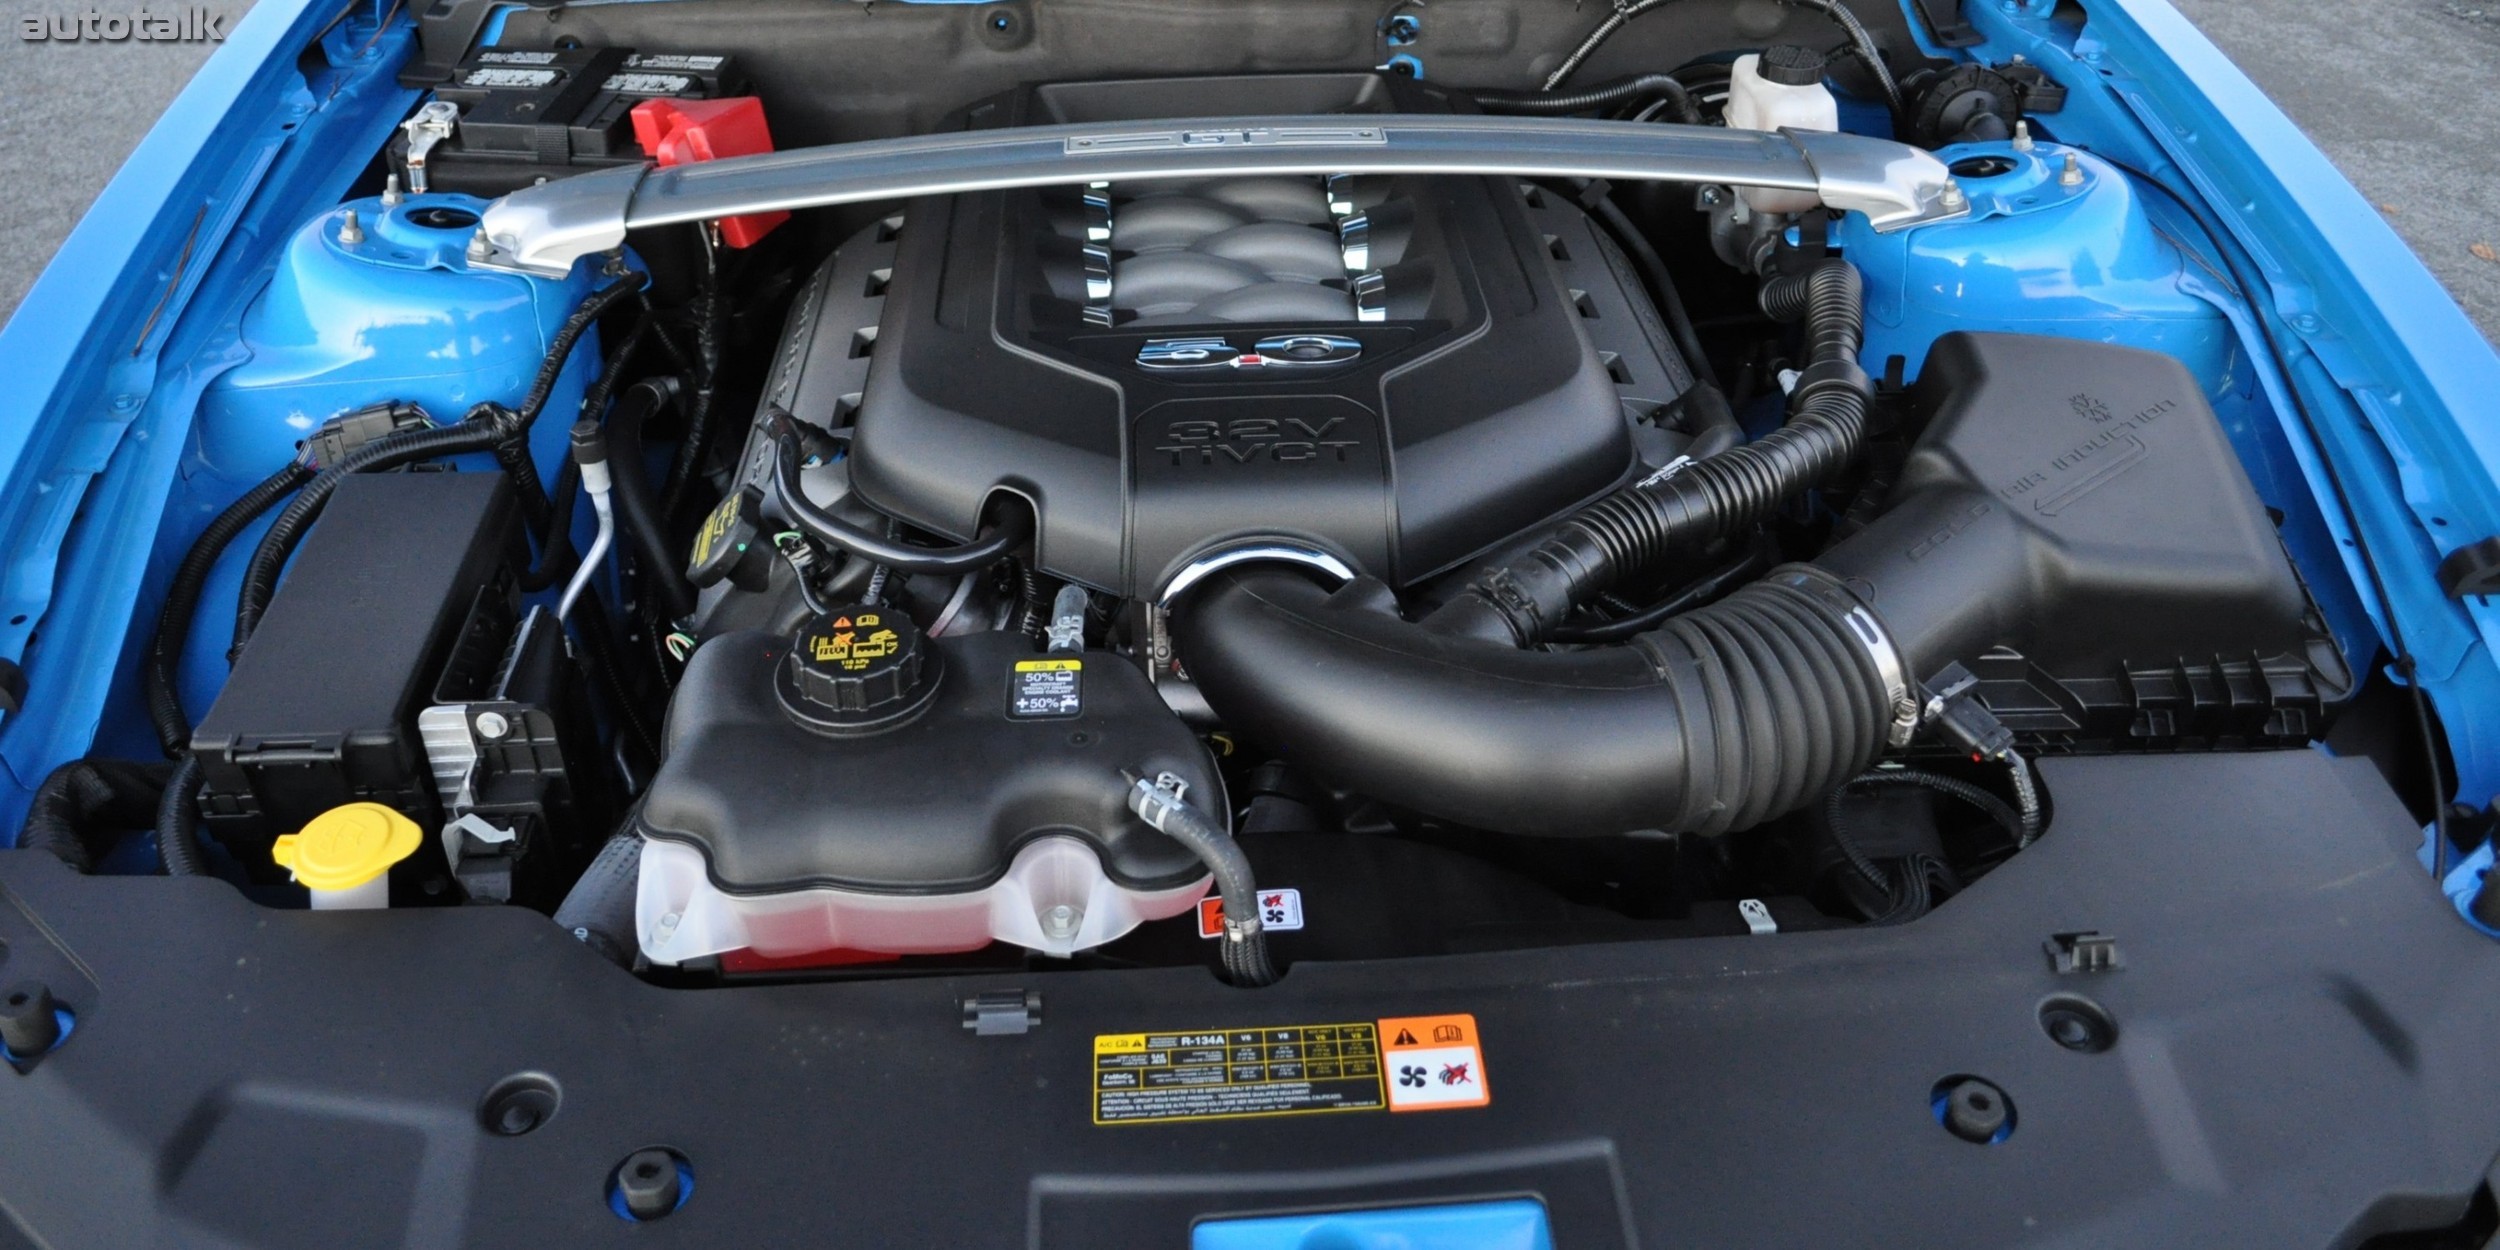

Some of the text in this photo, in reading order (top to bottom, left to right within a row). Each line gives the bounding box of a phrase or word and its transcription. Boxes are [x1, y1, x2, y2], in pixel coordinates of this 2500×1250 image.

[1182, 131, 1268, 146] GT
[1135, 334, 1362, 368] 5.0
[1168, 417, 1346, 442] 32V
[1025, 672, 1055, 683] 50%
[1181, 1034, 1225, 1046] R-134A
